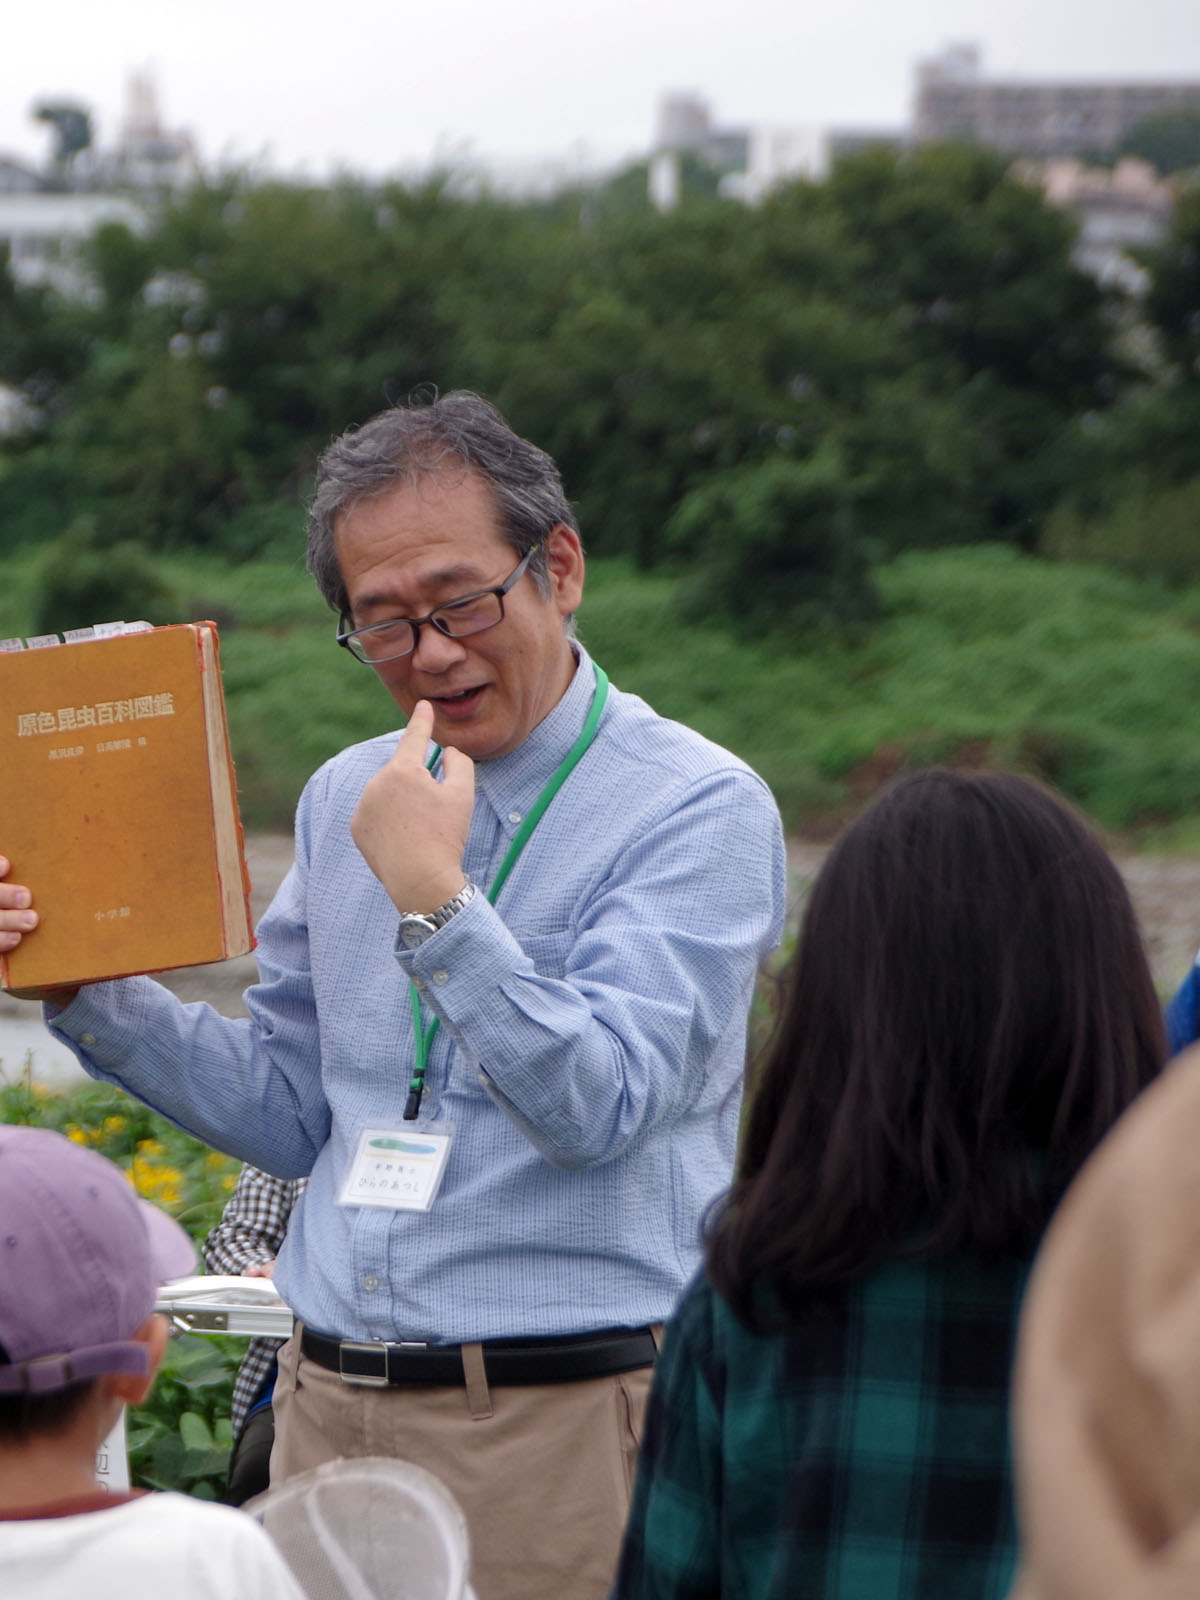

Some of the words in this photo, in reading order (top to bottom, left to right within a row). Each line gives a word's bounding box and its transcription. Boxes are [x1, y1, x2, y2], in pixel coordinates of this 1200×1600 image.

[17, 692, 176, 737] 原色昆虫百科図鑑
